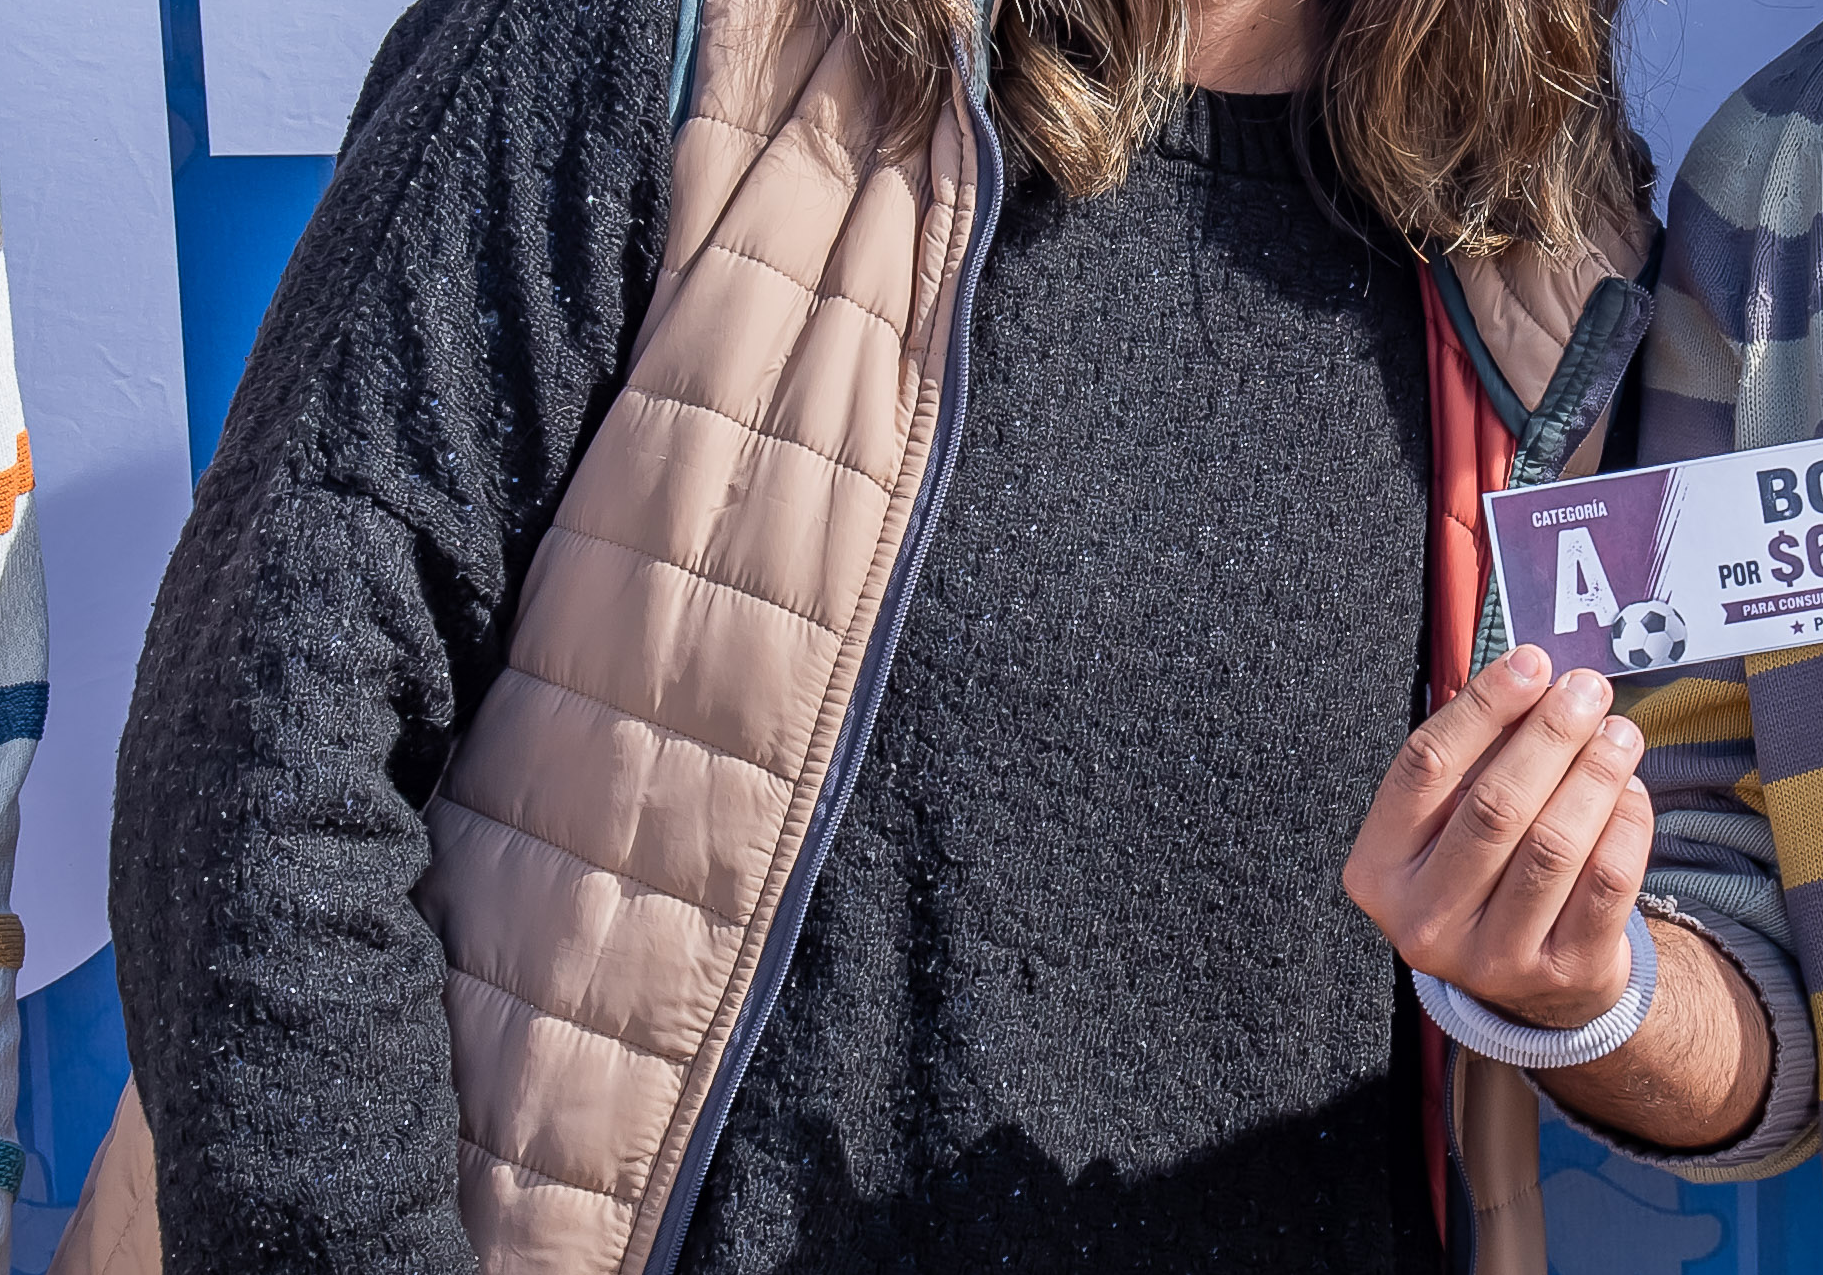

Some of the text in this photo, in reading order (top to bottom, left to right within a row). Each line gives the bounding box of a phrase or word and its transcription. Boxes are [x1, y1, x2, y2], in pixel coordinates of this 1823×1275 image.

[1531, 499, 1609, 528] CATEGORÍA
[1553, 526, 1621, 635] A
[1718, 560, 1762, 589] POR
[1742, 601, 1776, 617] PARA
